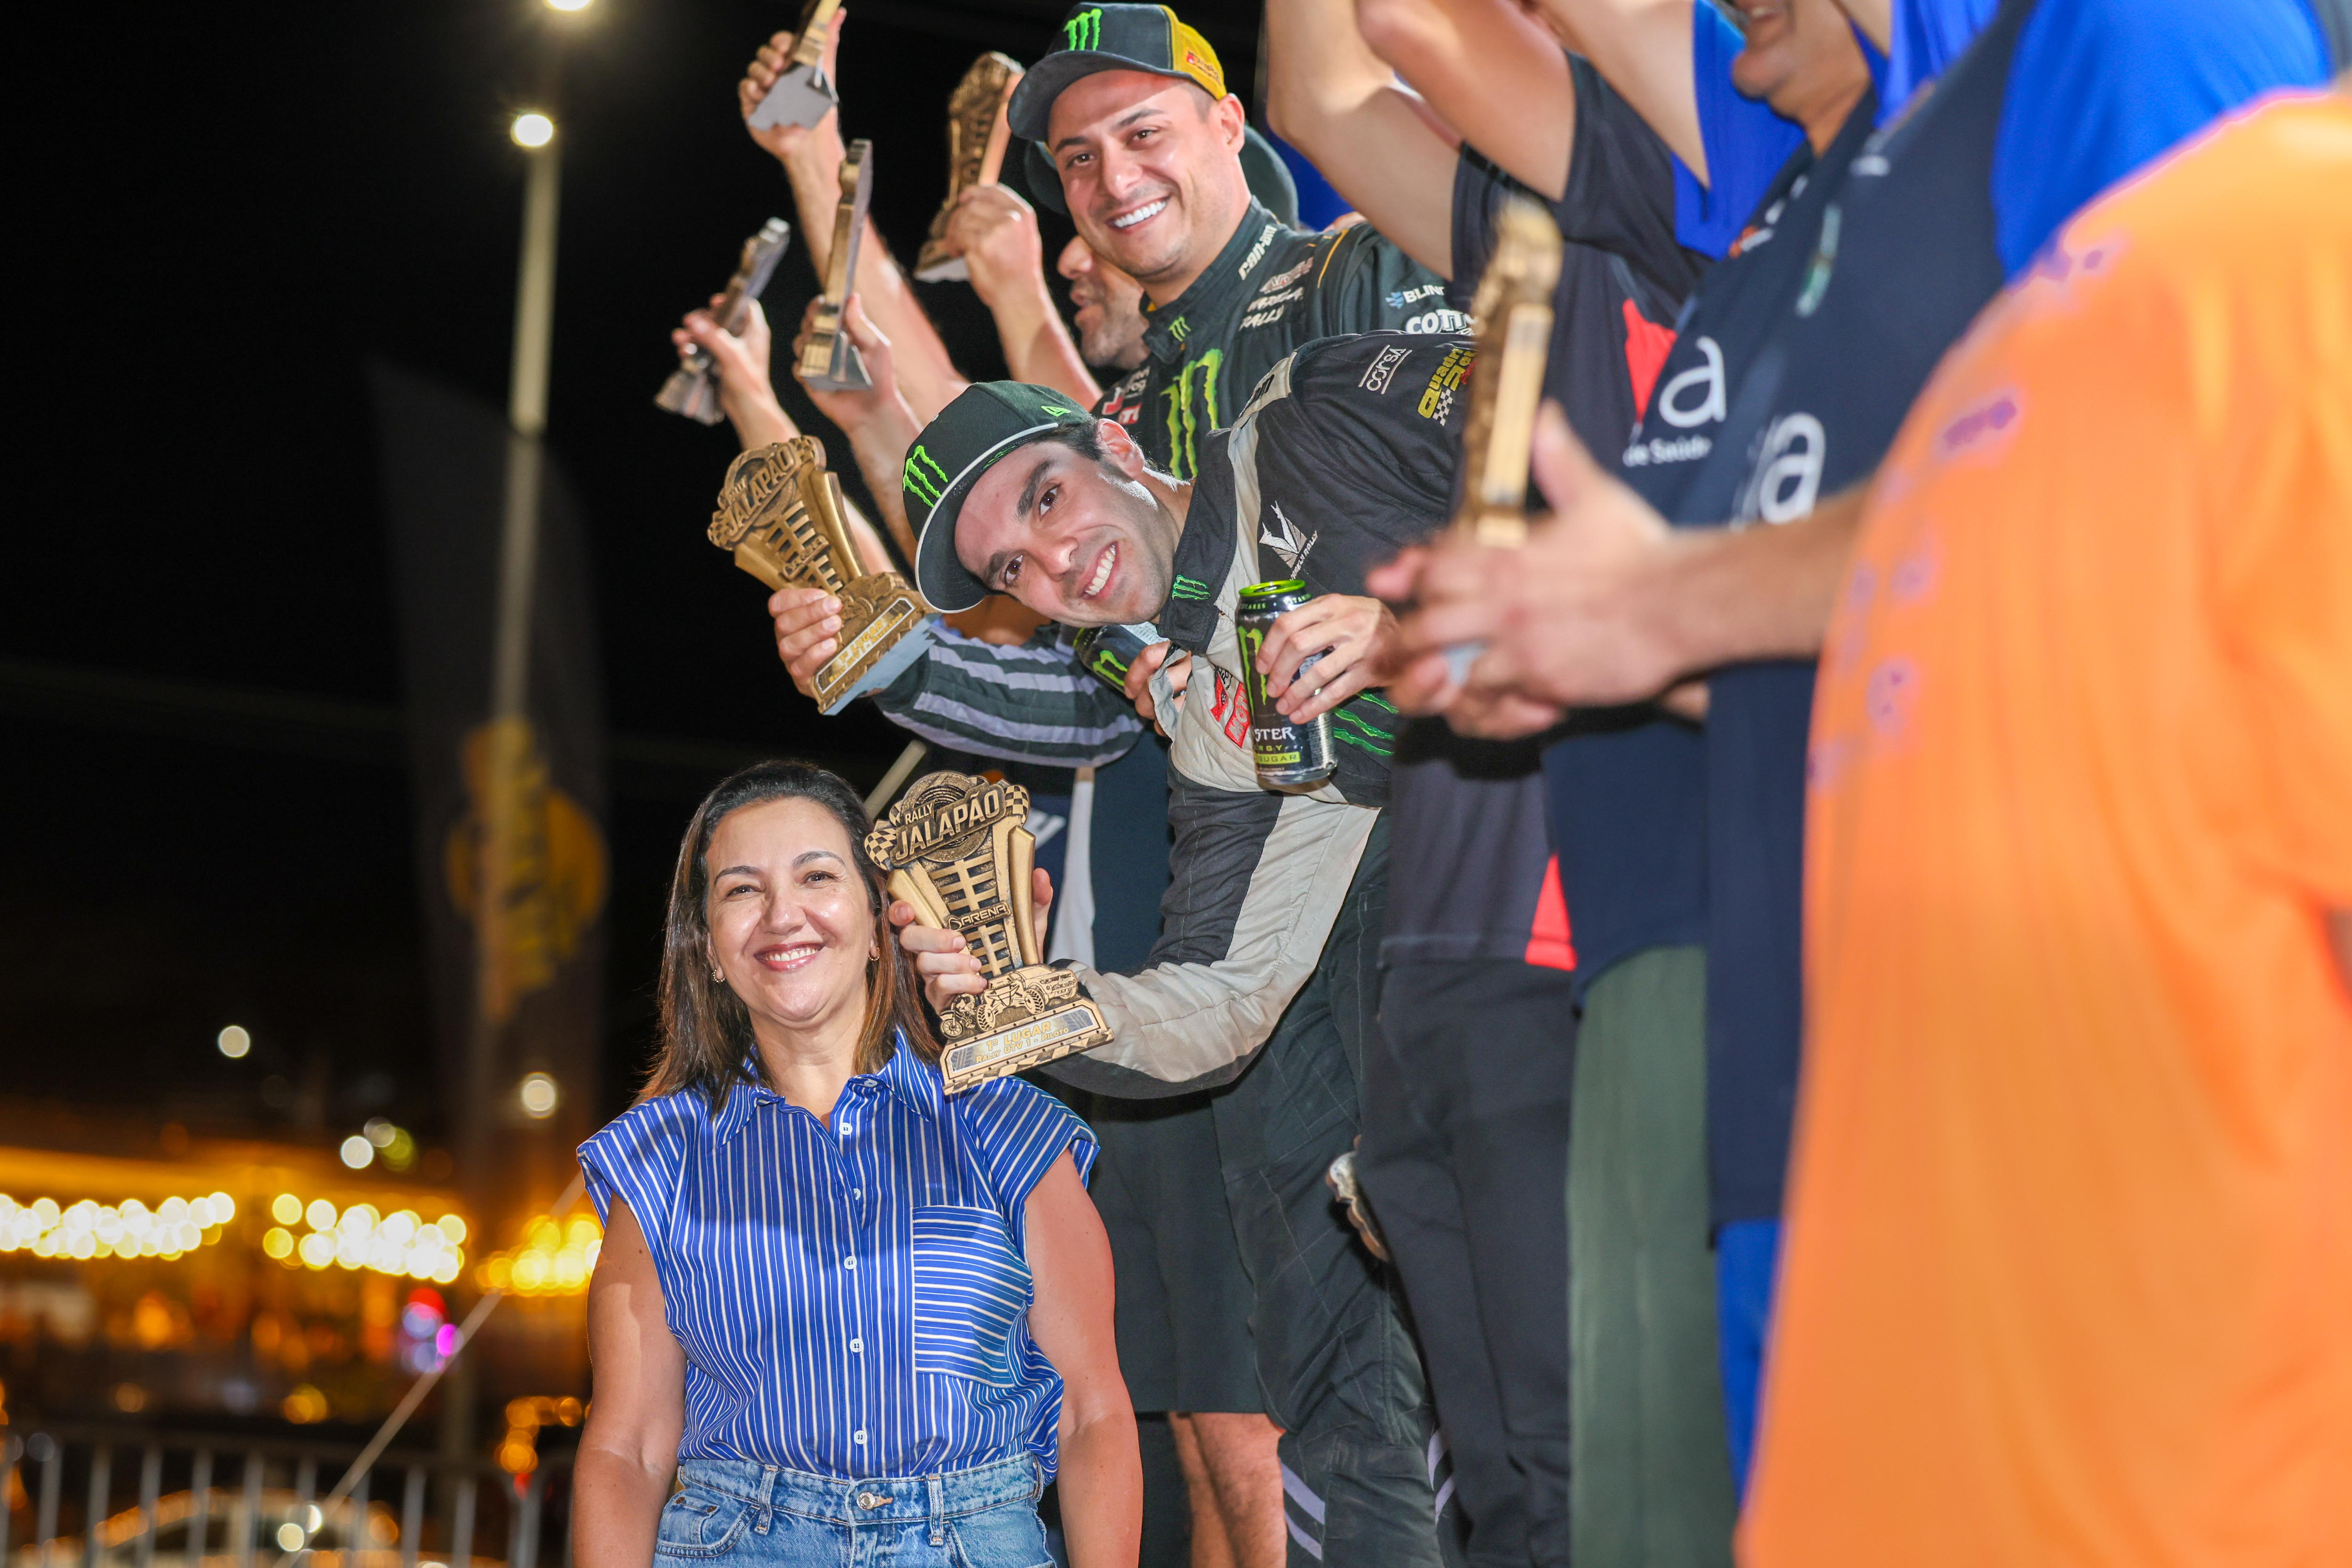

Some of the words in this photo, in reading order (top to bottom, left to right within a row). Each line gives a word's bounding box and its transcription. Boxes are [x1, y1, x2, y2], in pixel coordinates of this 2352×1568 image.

[1254, 727, 1296, 742] STER
[895, 790, 1000, 860] JALAPÃO
[905, 803, 933, 825] RALLY
[961, 905, 1007, 926] ARENA
[976, 1050, 1001, 1063] RALLY
[1004, 1042, 1023, 1054] UTV
[1042, 1027, 1069, 1041] PILOTO
[986, 1039, 998, 1051] 1º
[1004, 1022, 1051, 1046] LUGAR
